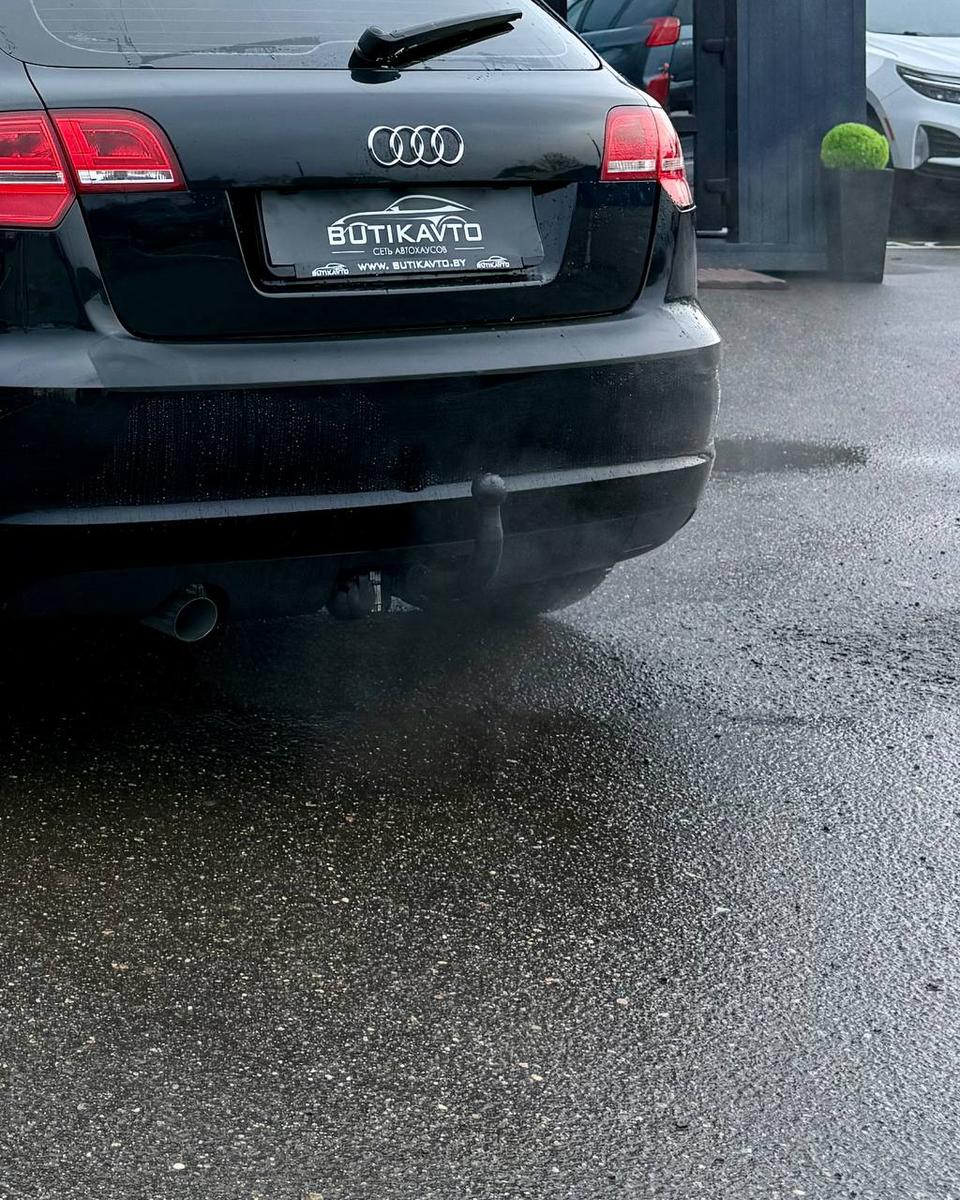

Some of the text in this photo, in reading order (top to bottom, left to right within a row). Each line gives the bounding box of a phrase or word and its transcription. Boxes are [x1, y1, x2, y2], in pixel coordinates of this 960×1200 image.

[327, 222, 483, 246] BUTIKAVTO
[372, 245, 448, 256] СЕТЬ АВТОХАУСОВ
